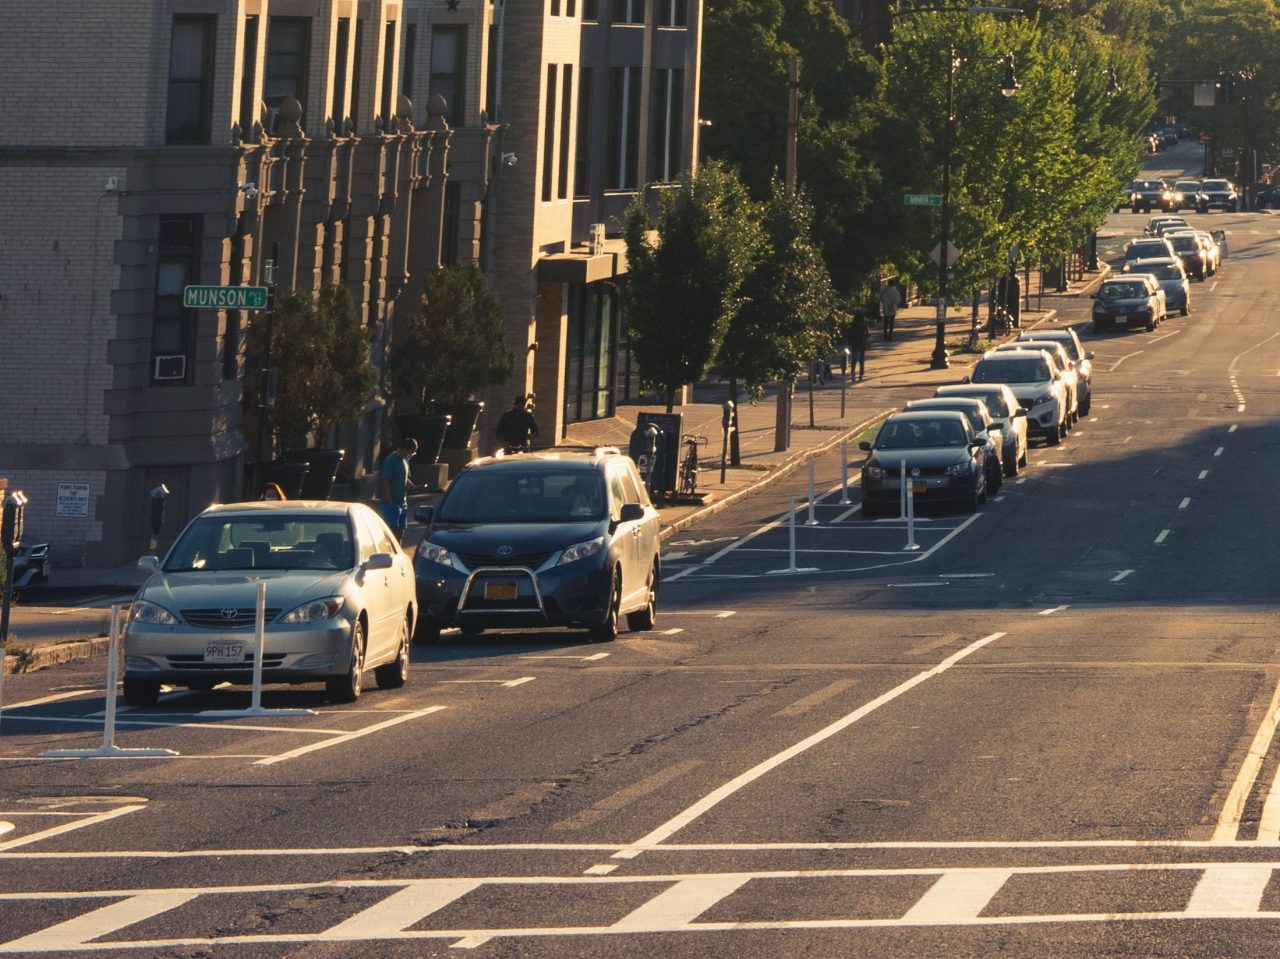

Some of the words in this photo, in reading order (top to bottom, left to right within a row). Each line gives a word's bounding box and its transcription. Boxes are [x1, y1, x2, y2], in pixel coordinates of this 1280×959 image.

[188, 290, 247, 305] MUNSON
[206, 645, 223, 657] 9PH
[226, 645, 243, 657] 157
